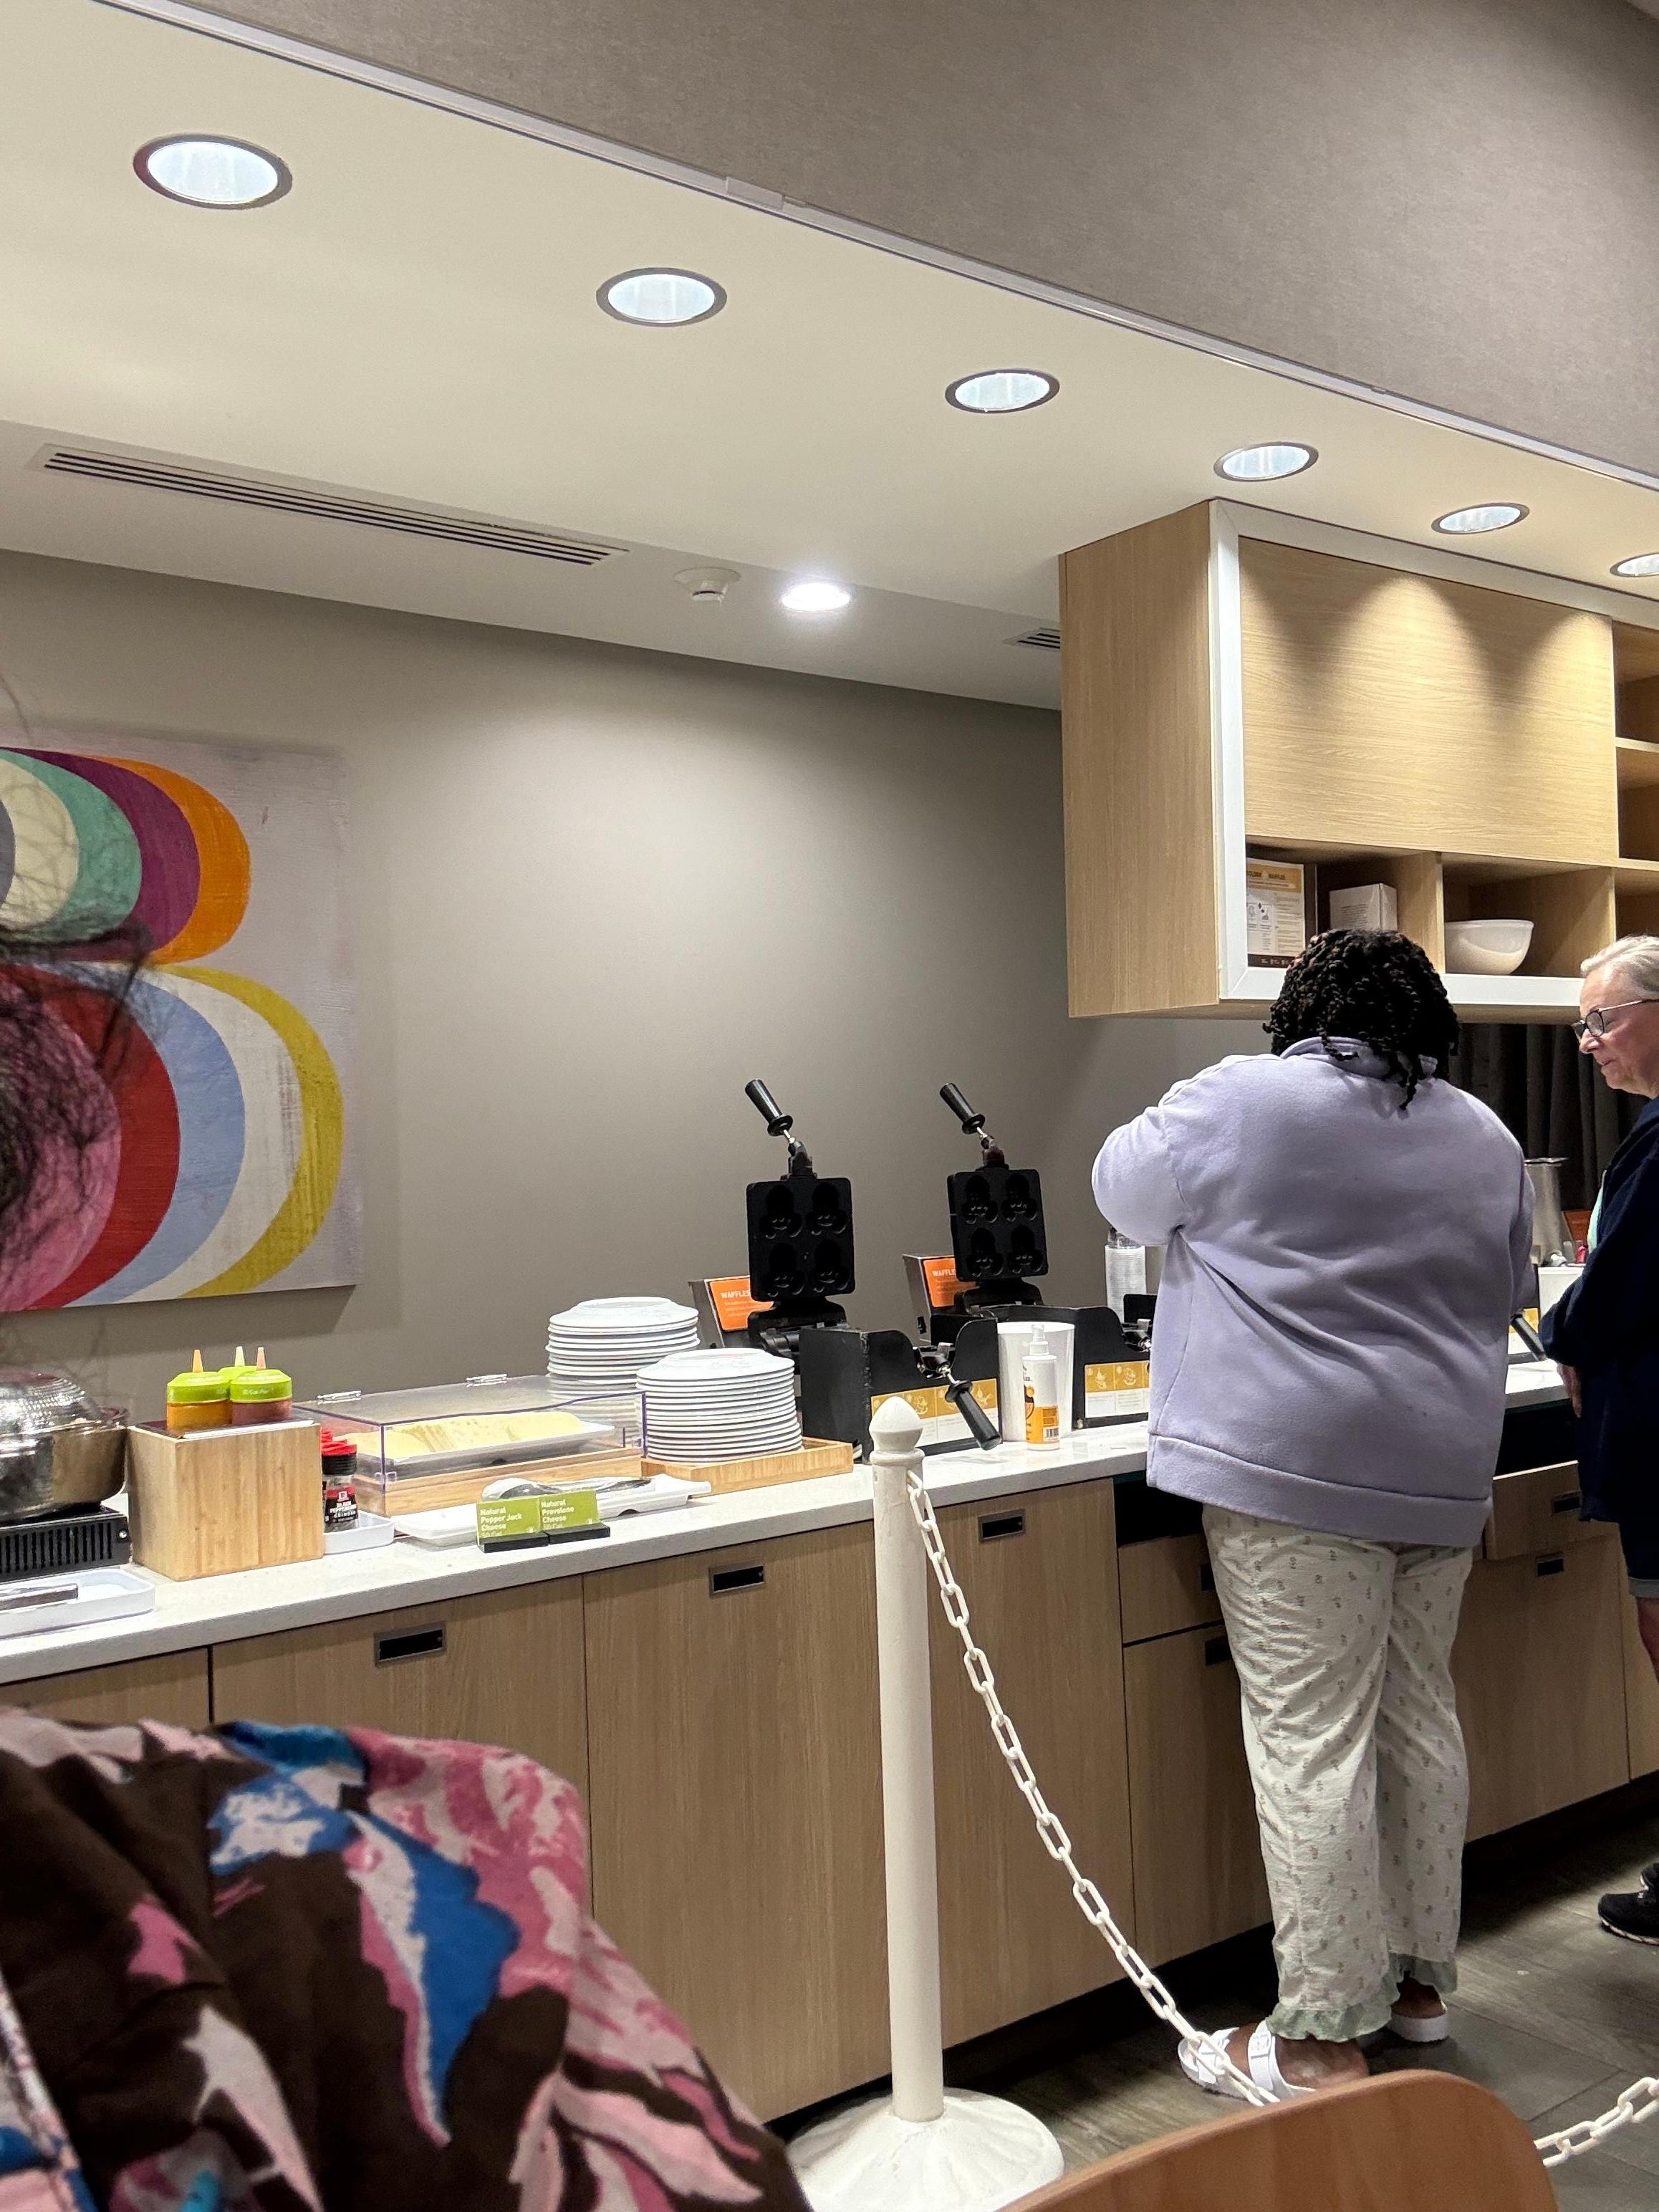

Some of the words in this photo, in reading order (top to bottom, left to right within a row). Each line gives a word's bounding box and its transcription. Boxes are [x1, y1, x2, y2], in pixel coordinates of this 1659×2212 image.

[542, 1499, 566, 1508] Natural
[480, 1506, 506, 1516] Natural
[542, 1506, 574, 1516] Provolone
[481, 1515, 506, 1526] Pepper
[506, 1513, 522, 1521] Jack
